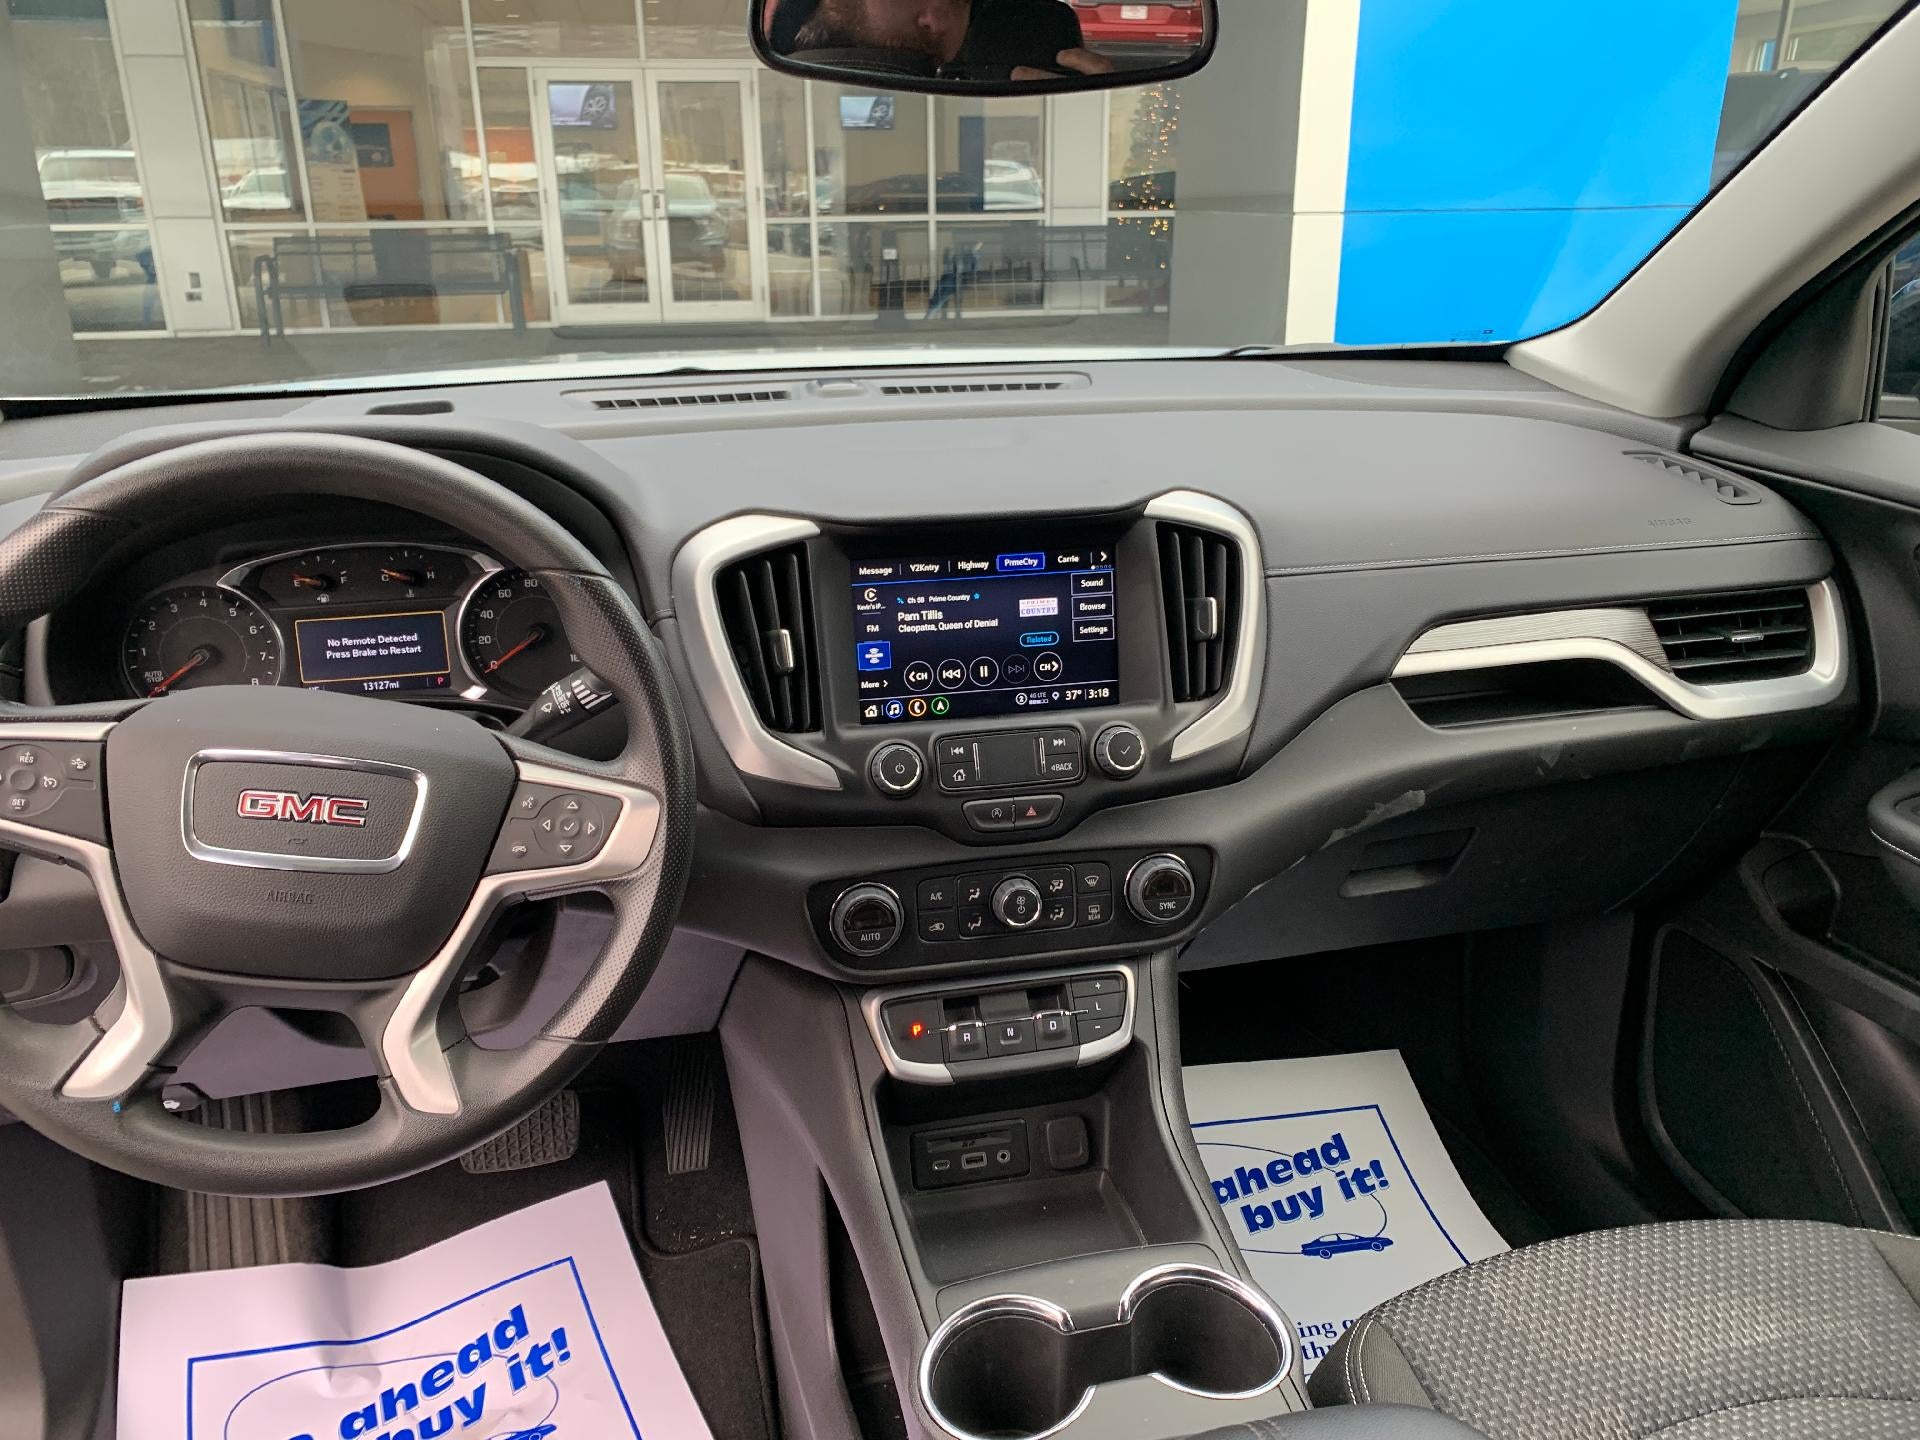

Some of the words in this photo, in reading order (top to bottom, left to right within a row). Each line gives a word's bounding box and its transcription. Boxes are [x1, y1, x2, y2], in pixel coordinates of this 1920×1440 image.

[1004, 557, 1038, 567] PrmeCtry
[1057, 555, 1080, 563] Carrie
[957, 560, 989, 571] Highway
[426, 570, 435, 579] H
[858, 567, 893, 576] Message
[524, 579, 538, 588] 80
[1080, 578, 1104, 588] Sound
[498, 588, 512, 598] 60
[199, 599, 208, 608] 4
[928, 595, 946, 603] Prime
[946, 594, 971, 602] Country
[169, 603, 178, 613] 3
[1020, 606, 1057, 616] COUNTRY
[1079, 602, 1106, 611] Browse
[228, 607, 237, 617] 5
[480, 609, 494, 619] 40
[897, 612, 920, 622] Pam
[920, 609, 944, 620] Tillis
[149, 621, 157, 631] 2
[249, 625, 257, 635] 6
[866, 624, 880, 633] FM
[898, 623, 938, 634] Cleopatra,
[938, 621, 963, 631] Queen
[964, 619, 973, 629] of
[973, 618, 999, 628] Denial
[1079, 625, 1109, 635] Settings
[327, 639, 341, 648] No
[342, 635, 376, 647] Remote
[377, 632, 418, 645] Detected
[478, 635, 492, 645] 20
[1026, 634, 1052, 644] Related
[140, 647, 147, 657] 1
[259, 651, 267, 661] 7
[326, 650, 351, 660] Press
[352, 648, 377, 658] Brake
[378, 647, 388, 656] to
[389, 644, 422, 655] Restart
[1040, 663, 1051, 671] CH
[144, 670, 163, 678] AUTO
[915, 671, 928, 680] CH
[436, 677, 444, 685] P
[861, 680, 880, 689] More
[1065, 689, 1082, 700] 37°
[1088, 687, 1110, 699] 3:18
[19, 755, 35, 764] RES
[1055, 762, 1073, 771] BACK
[11, 798, 26, 807] SET
[237, 788, 369, 828] GMC
[266, 889, 314, 905] AIRBAG
[930, 892, 943, 900] A/C
[1159, 900, 1177, 910] SYNC
[860, 931, 881, 941] AUTO
[1094, 1002, 1102, 1011] L
[911, 1023, 923, 1037] P
[1049, 1019, 1058, 1031] D
[962, 1031, 972, 1043] R
[1006, 1026, 1015, 1038] N
[1210, 1132, 1351, 1205] ahead
[1239, 1185, 1325, 1235] buy
[1334, 1159, 1391, 1202] it!
[505, 1326, 572, 1395] it!
[338, 1303, 530, 1440] ahead
